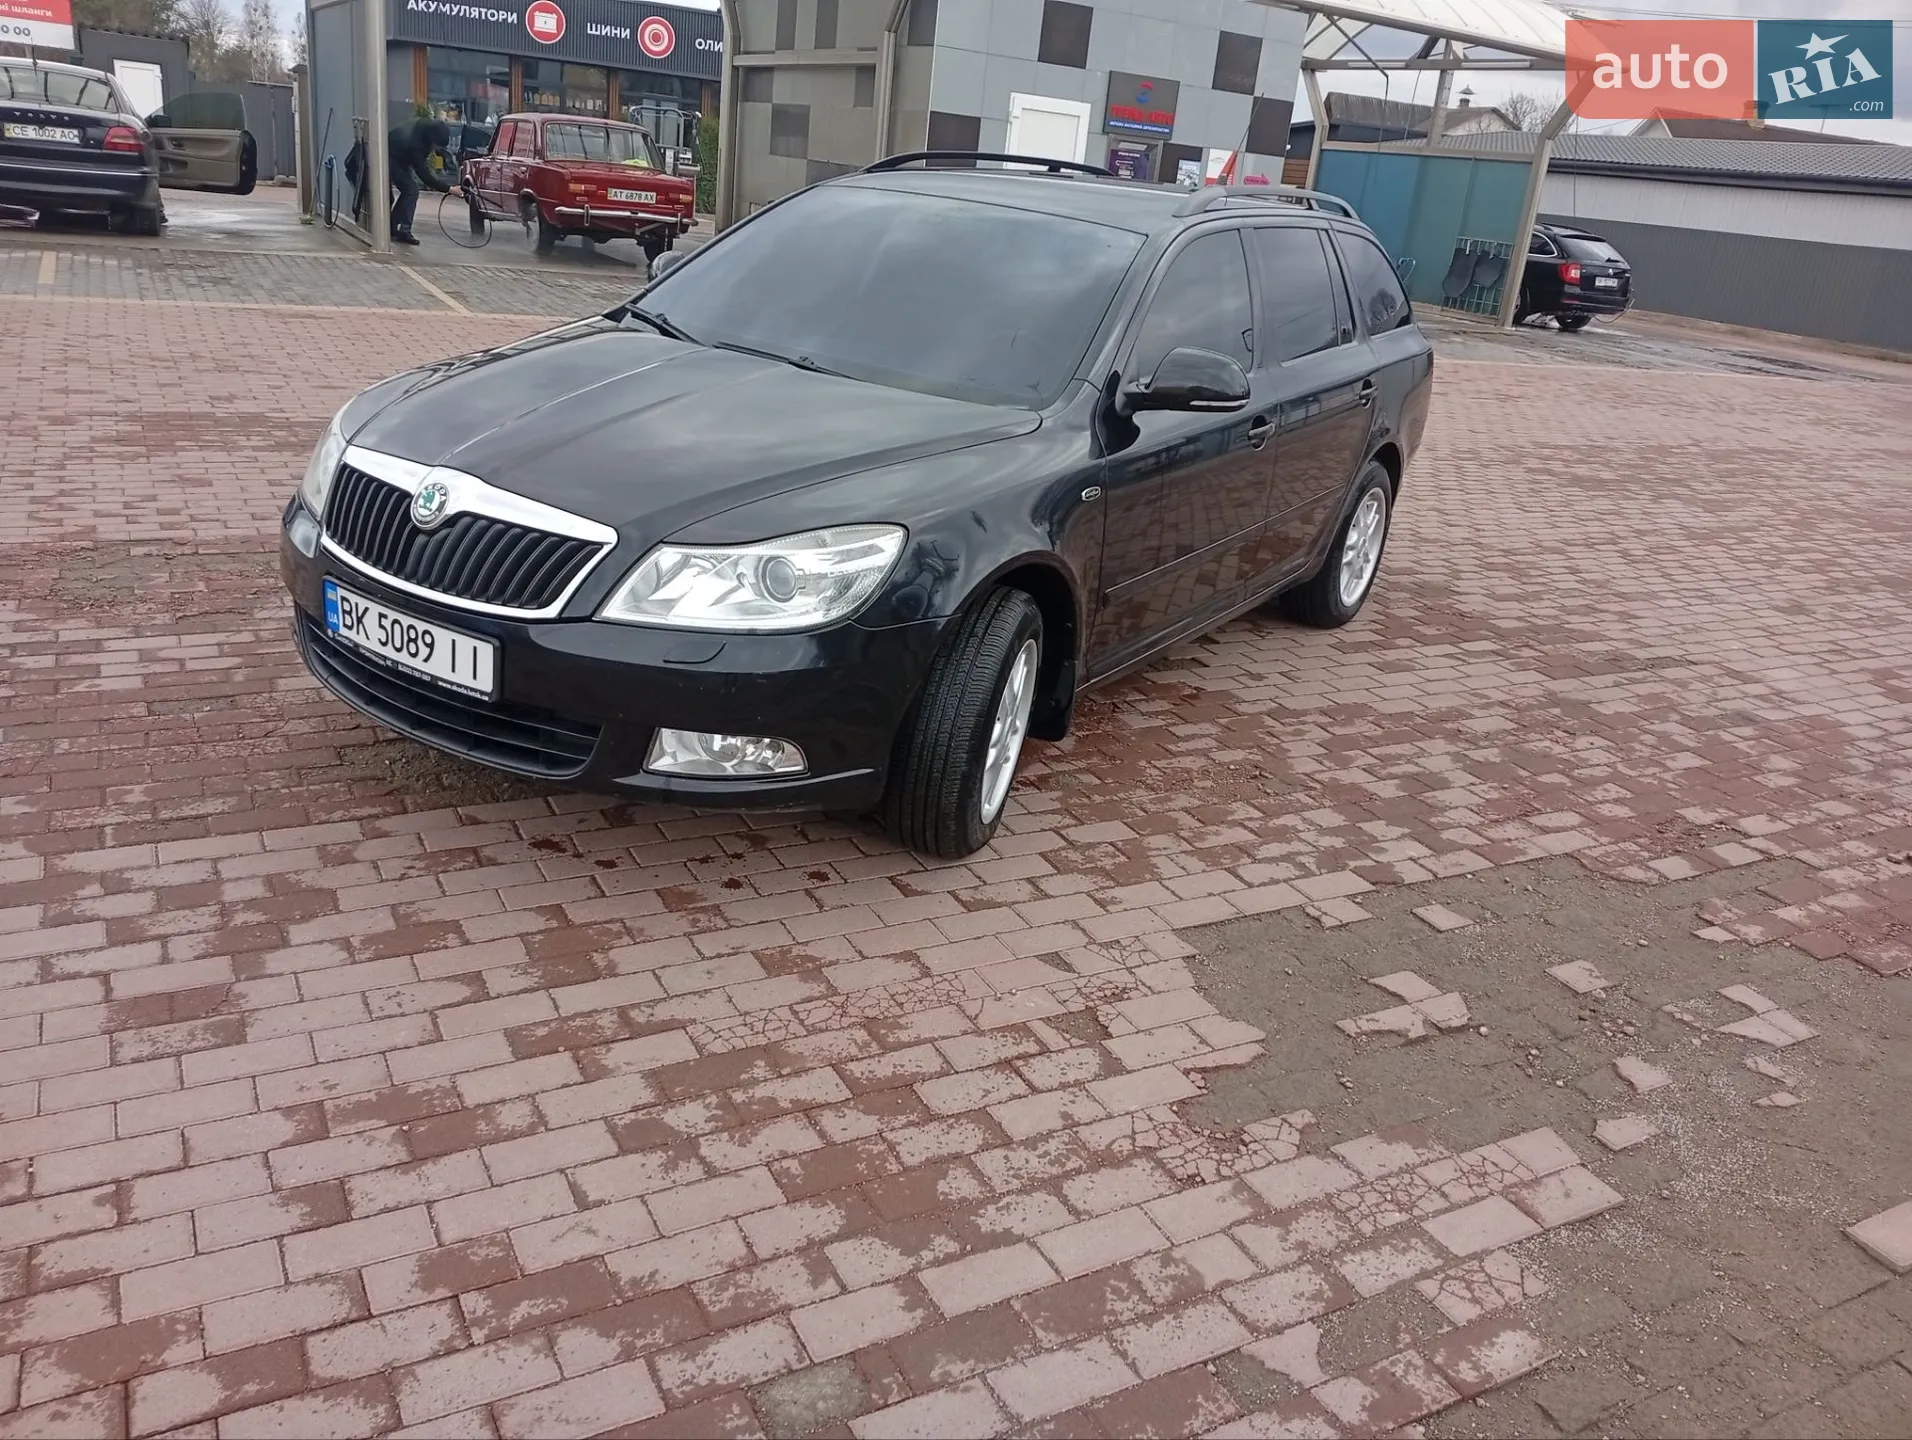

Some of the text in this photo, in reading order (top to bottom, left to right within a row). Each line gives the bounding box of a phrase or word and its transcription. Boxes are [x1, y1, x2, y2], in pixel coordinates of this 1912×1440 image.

[11, 4, 53, 17] шланги
[406, 0, 518, 24] АКУМУЛЯТОРИ
[586, 22, 631, 40] ШИНИ
[12, 125, 29, 137] CE
[31, 127, 57, 139] 1002
[613, 190, 624, 199] AT
[327, 611, 339, 625] UA
[340, 595, 370, 641] BK
[377, 611, 435, 664] 5089
